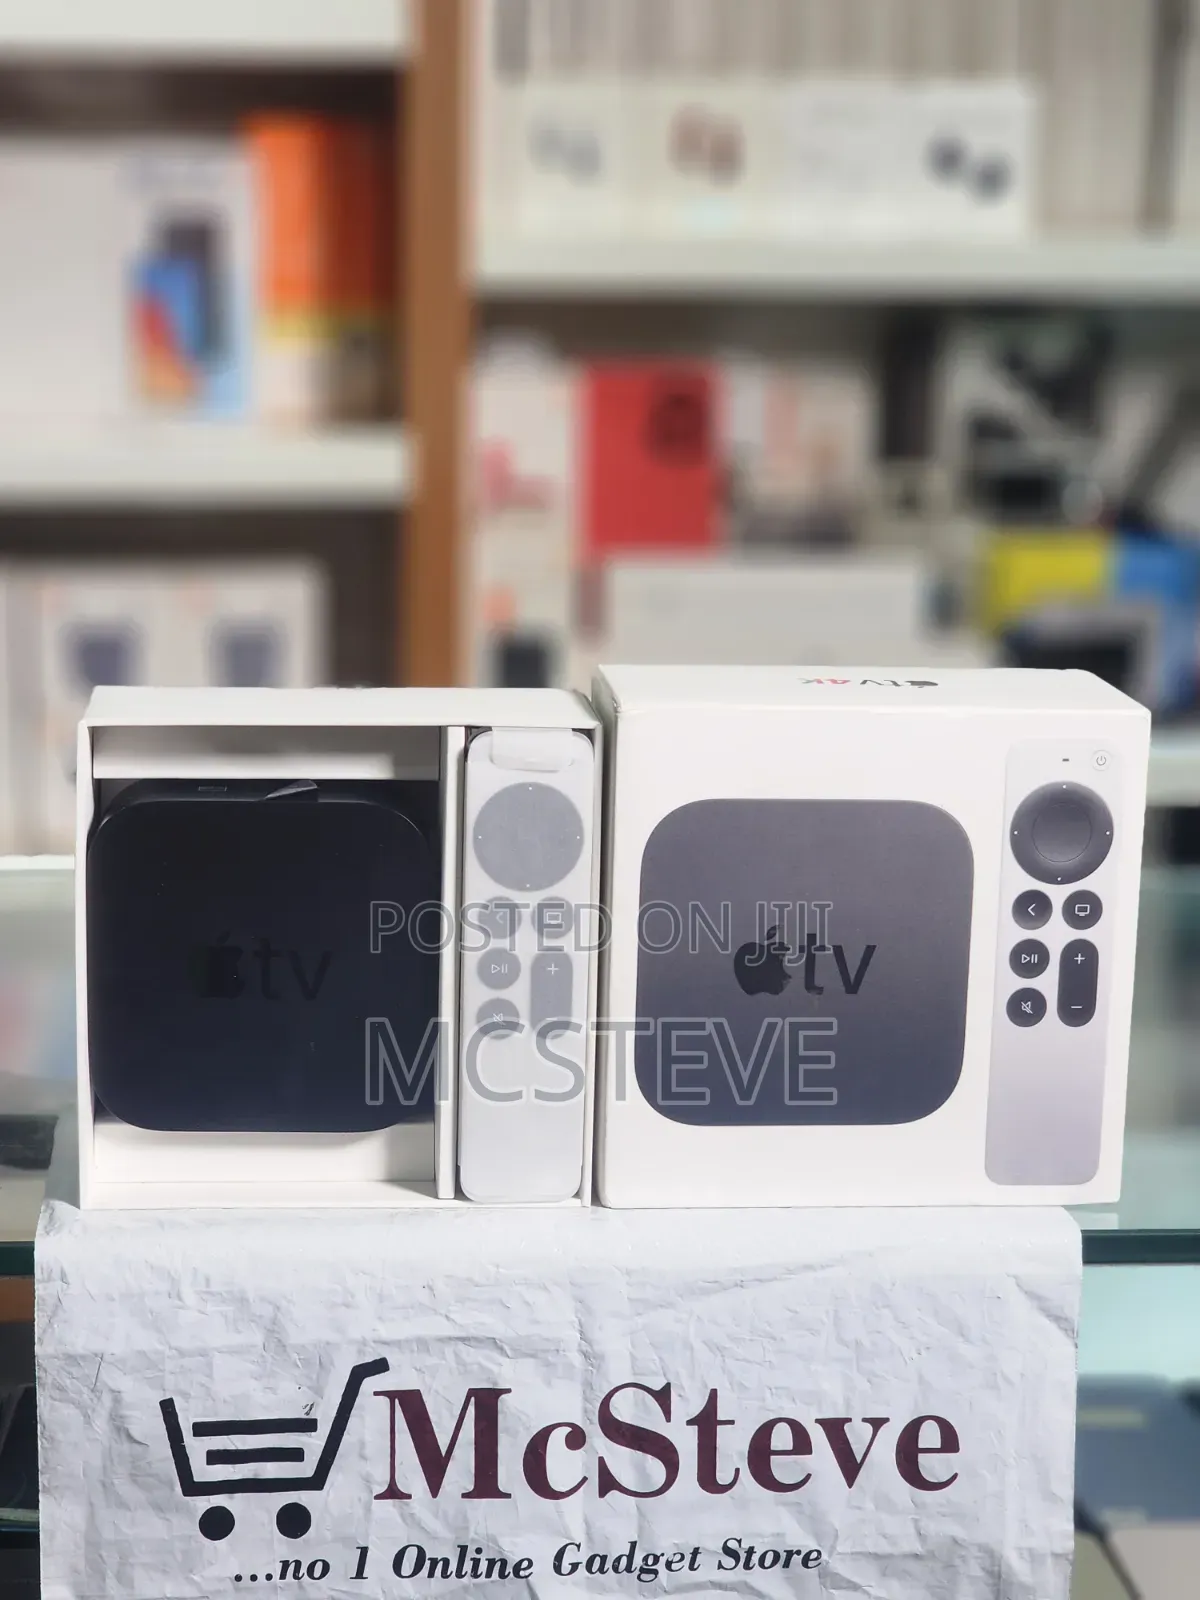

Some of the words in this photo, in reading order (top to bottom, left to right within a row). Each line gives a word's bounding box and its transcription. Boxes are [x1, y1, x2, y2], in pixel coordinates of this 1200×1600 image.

[252, 937, 333, 1001] tv
[798, 933, 877, 995] tv
[373, 1382, 960, 1501] McSteve
[349, 1546, 369, 1580] 1
[392, 1544, 534, 1580] Online
[552, 1540, 702, 1583] Gadget
[717, 1537, 823, 1571] Store
